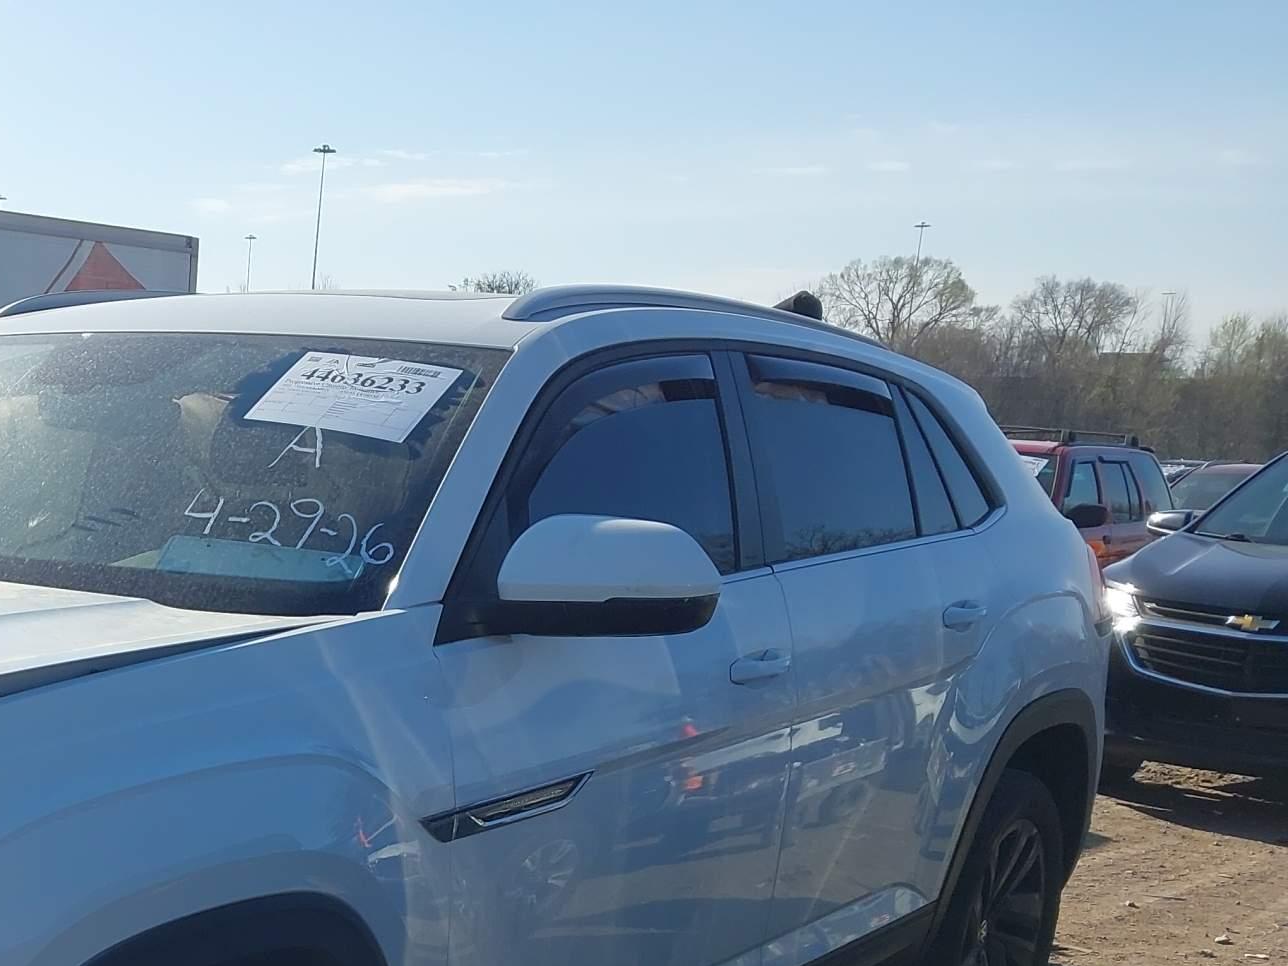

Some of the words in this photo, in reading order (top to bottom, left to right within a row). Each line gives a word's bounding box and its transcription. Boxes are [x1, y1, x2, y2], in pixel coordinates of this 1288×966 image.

[300, 367, 427, 395] 44636233
[268, 425, 323, 468] A
[184, 487, 396, 576] 4-29-26
